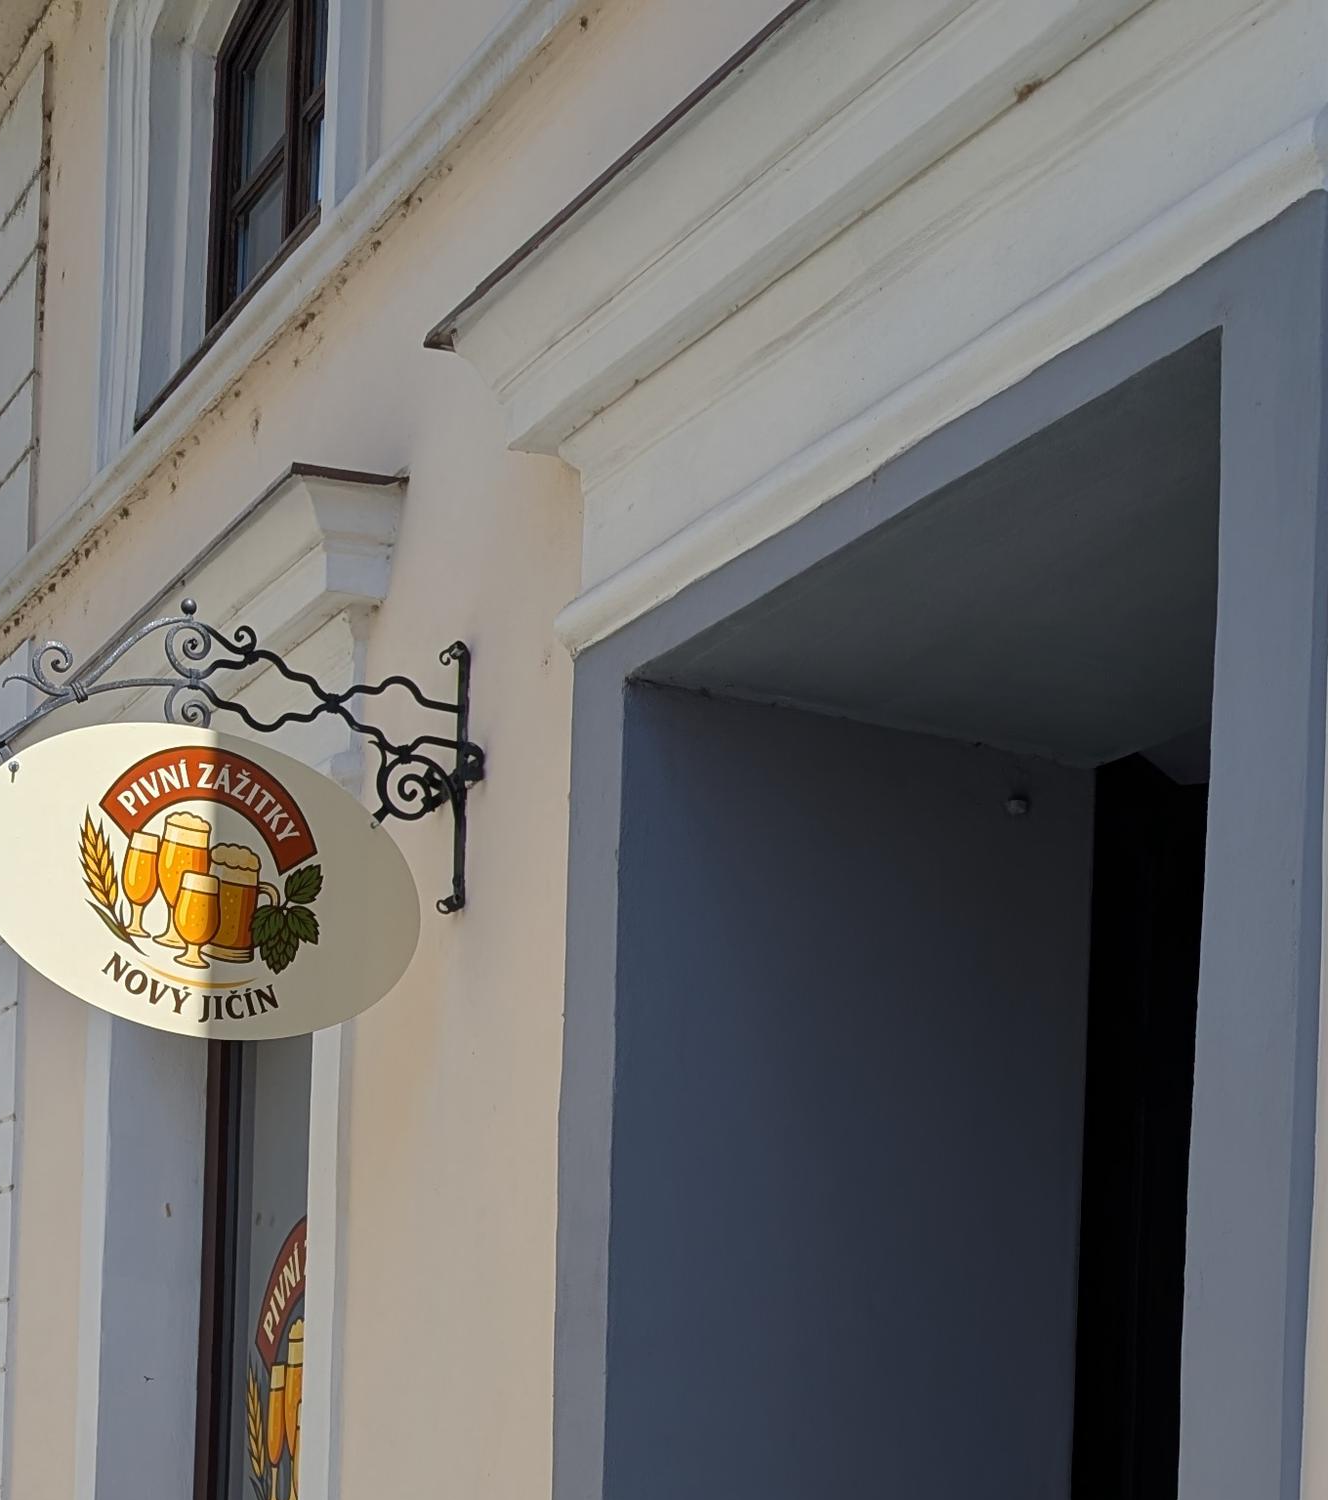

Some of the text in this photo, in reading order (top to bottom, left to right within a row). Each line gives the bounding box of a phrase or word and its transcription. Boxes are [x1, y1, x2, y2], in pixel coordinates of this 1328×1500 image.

[116, 759, 301, 843] PIVNÍ ZÁŽITKY
[101, 951, 280, 1023] NOVÝ JIČÍN
[263, 1242, 301, 1345] PIVNÍ
